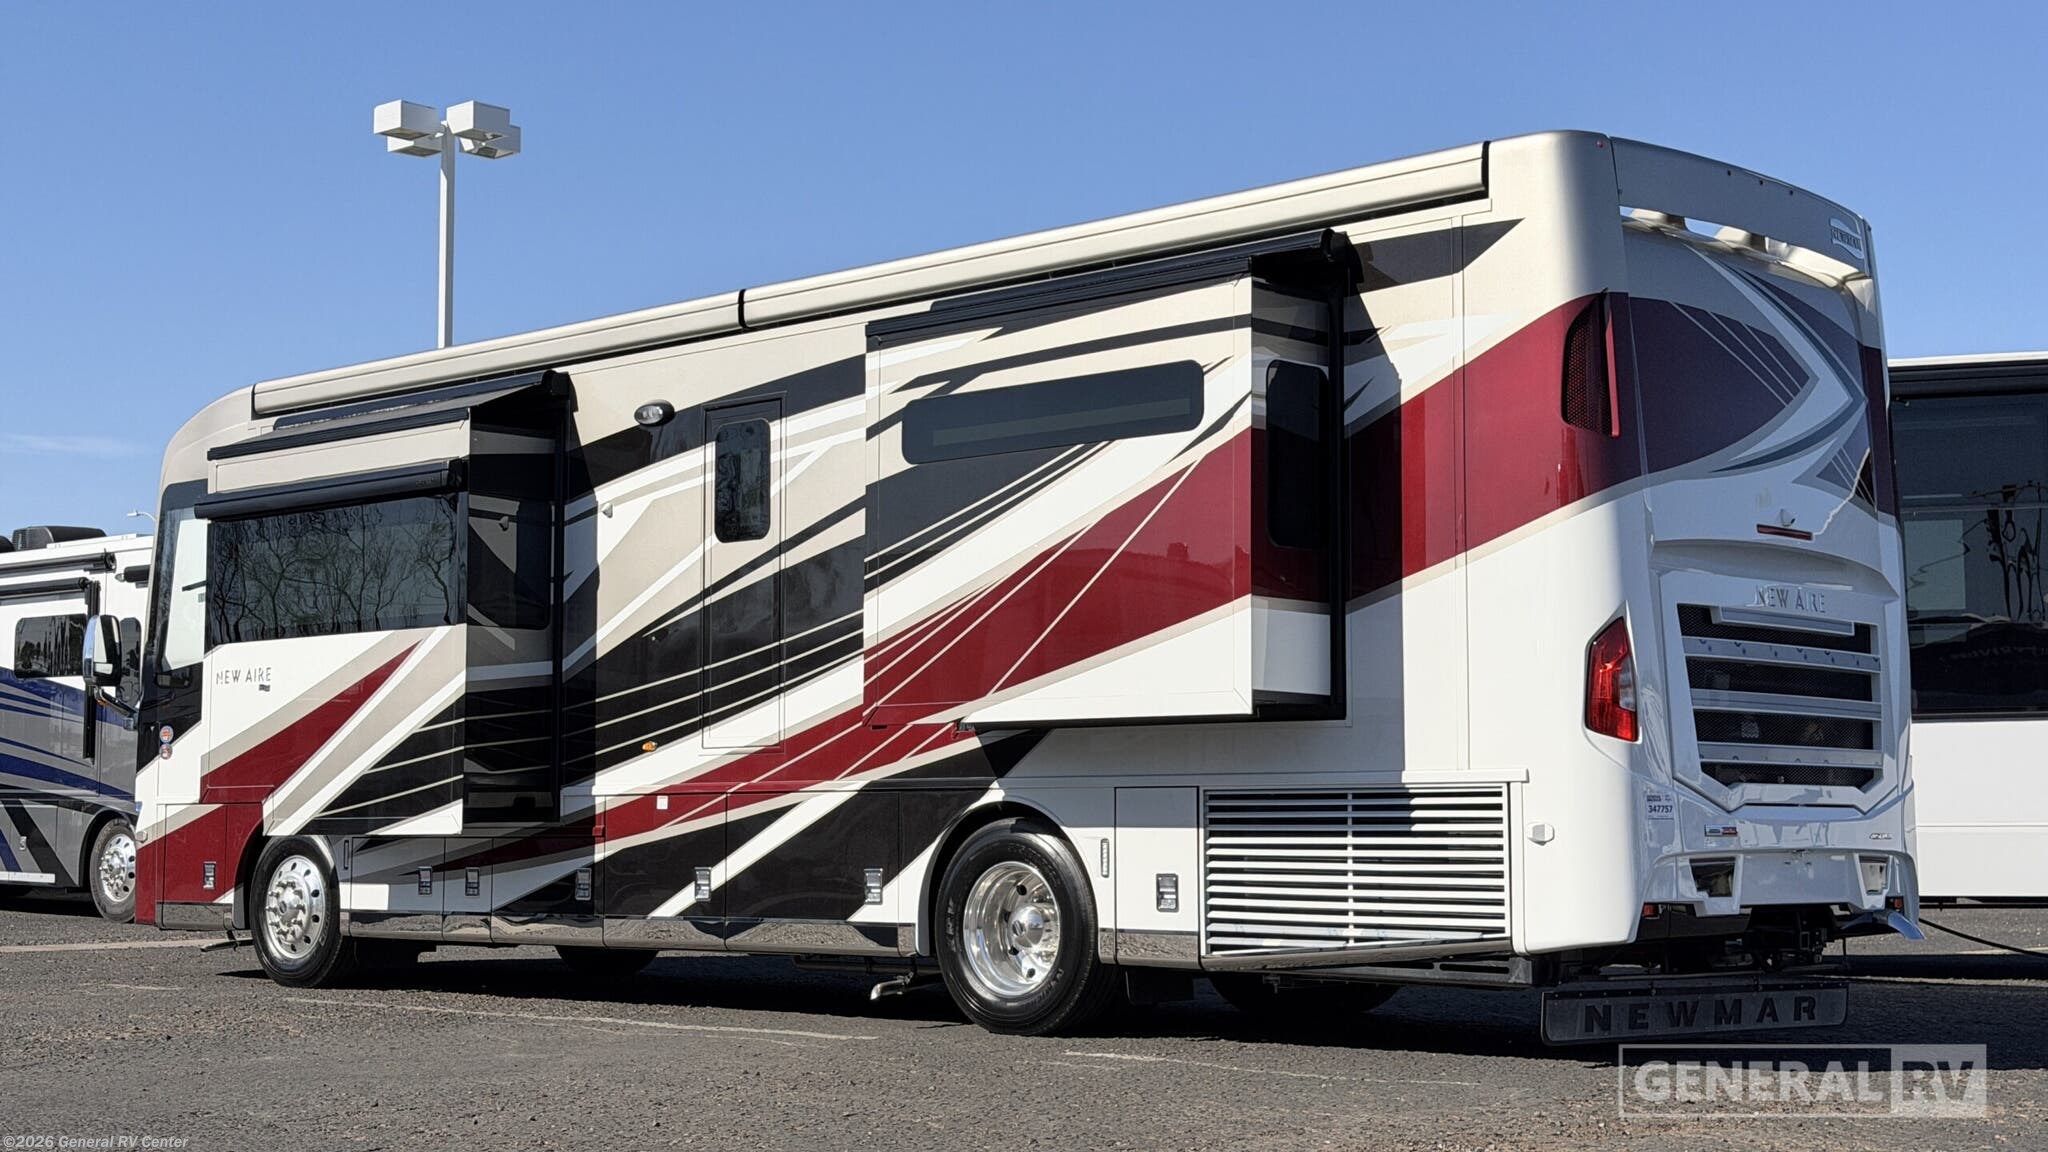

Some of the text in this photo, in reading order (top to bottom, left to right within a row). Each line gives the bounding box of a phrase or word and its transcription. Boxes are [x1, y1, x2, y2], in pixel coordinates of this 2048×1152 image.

[1754, 585, 1826, 614] NEW AIRE
[215, 666, 271, 685] NEW AIRE
[1647, 803, 1674, 815] 347757
[1584, 995, 1817, 1034] NEWMAR
